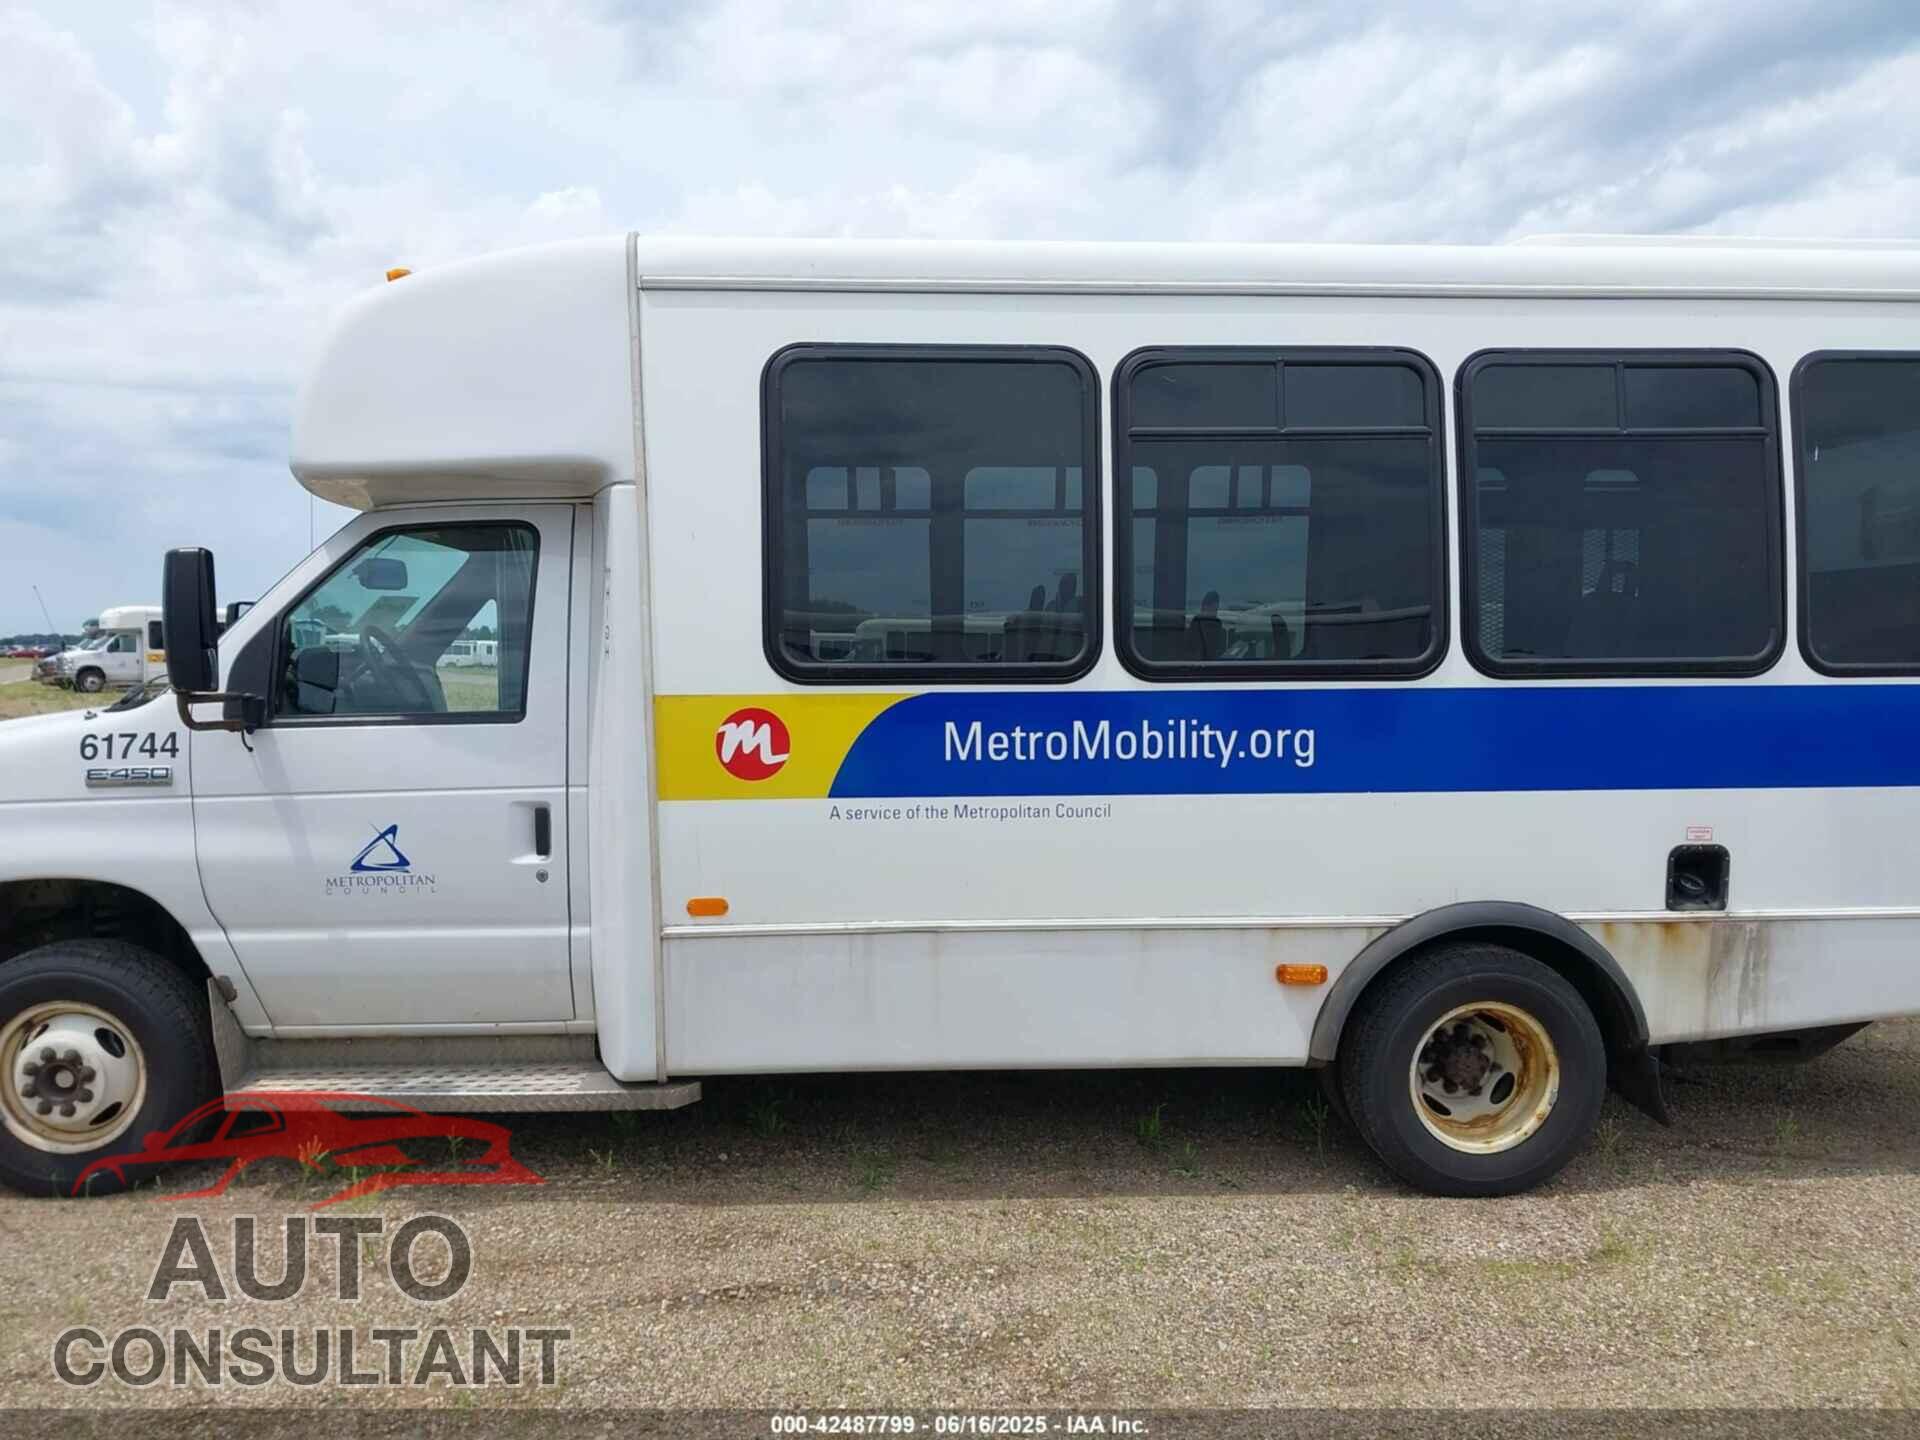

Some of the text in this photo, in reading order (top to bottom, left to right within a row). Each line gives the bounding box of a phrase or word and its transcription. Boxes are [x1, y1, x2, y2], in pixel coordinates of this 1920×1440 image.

[80, 731, 179, 760] 61744
[944, 719, 1316, 769] MetroMobility.org
[829, 802, 1111, 821] A service of the Metropolitan Council
[326, 874, 436, 887] METROPOLITAN
